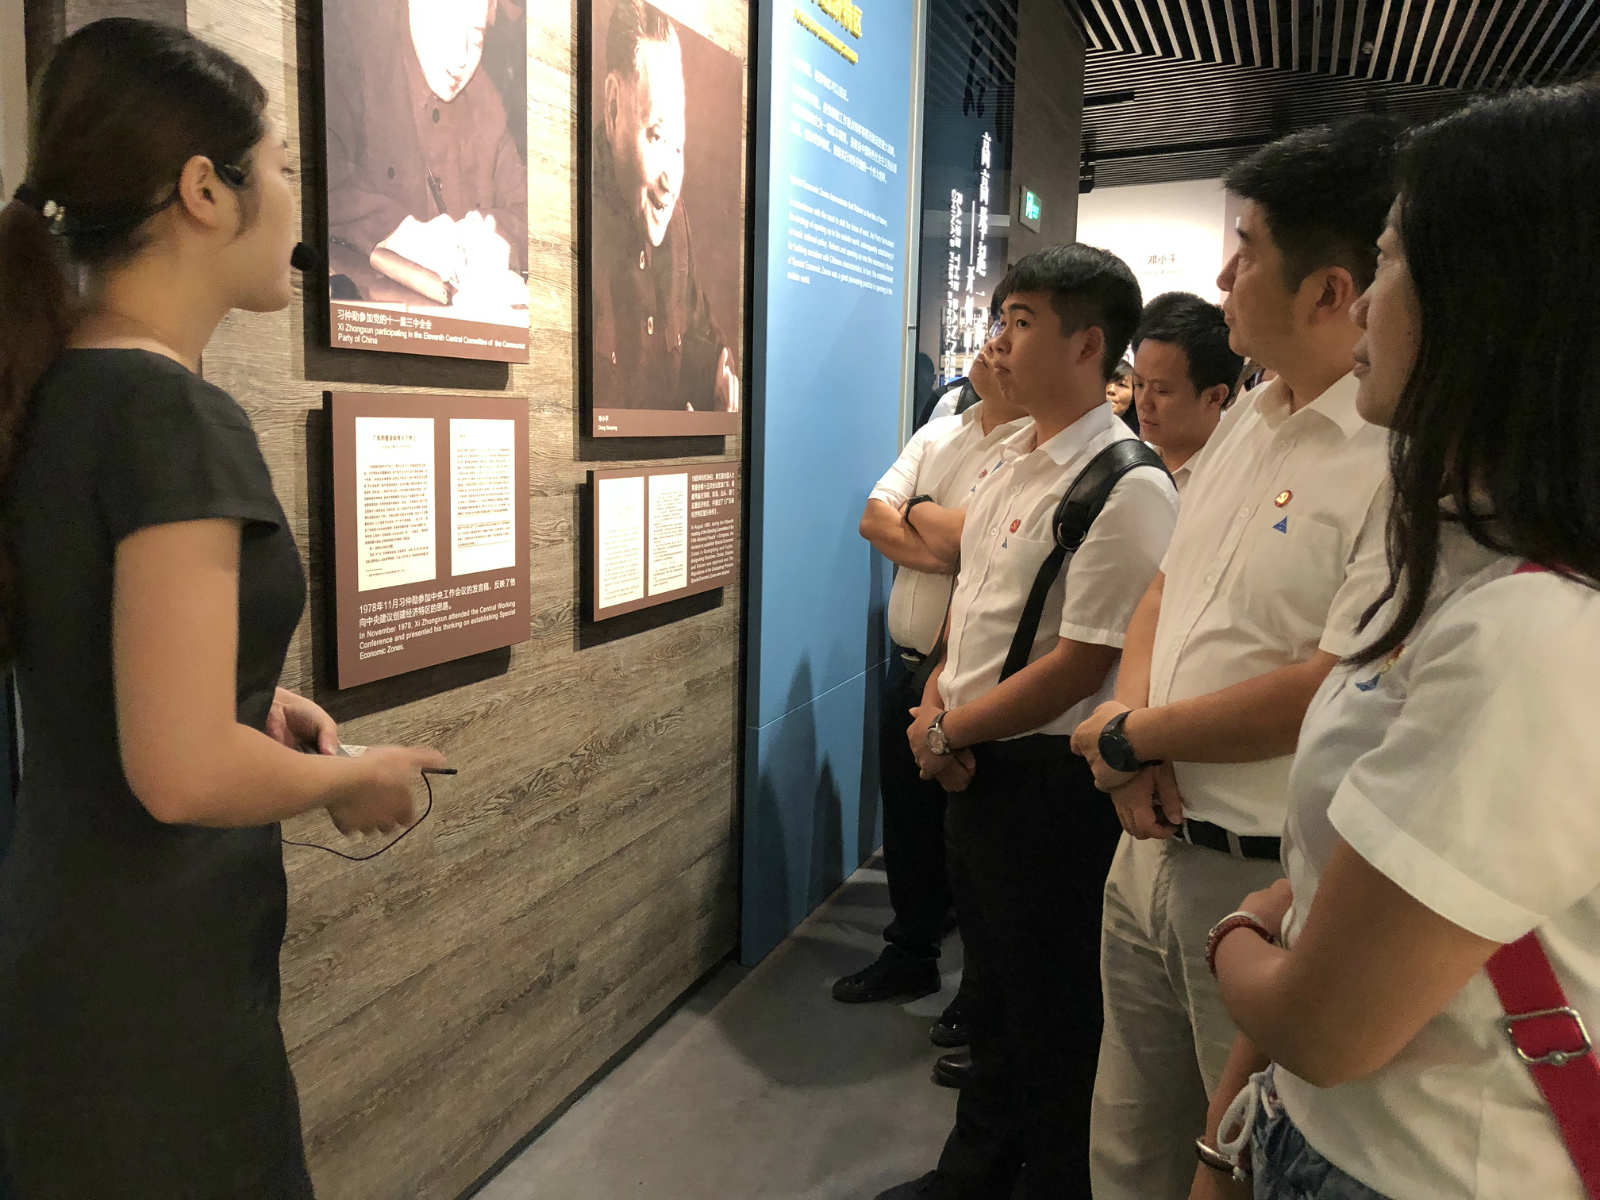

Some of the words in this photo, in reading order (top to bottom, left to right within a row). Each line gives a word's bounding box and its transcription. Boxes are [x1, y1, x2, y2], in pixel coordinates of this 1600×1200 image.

[337, 323, 344, 332] Xi
[337, 333, 353, 344] Party
[361, 335, 378, 345] China
[367, 626, 396, 638] November
[471, 608, 479, 616] the
[480, 603, 496, 613] Central
[360, 637, 393, 649] Conference
[394, 633, 405, 642] and
[406, 627, 433, 640] presented
[360, 647, 386, 660] Economic
